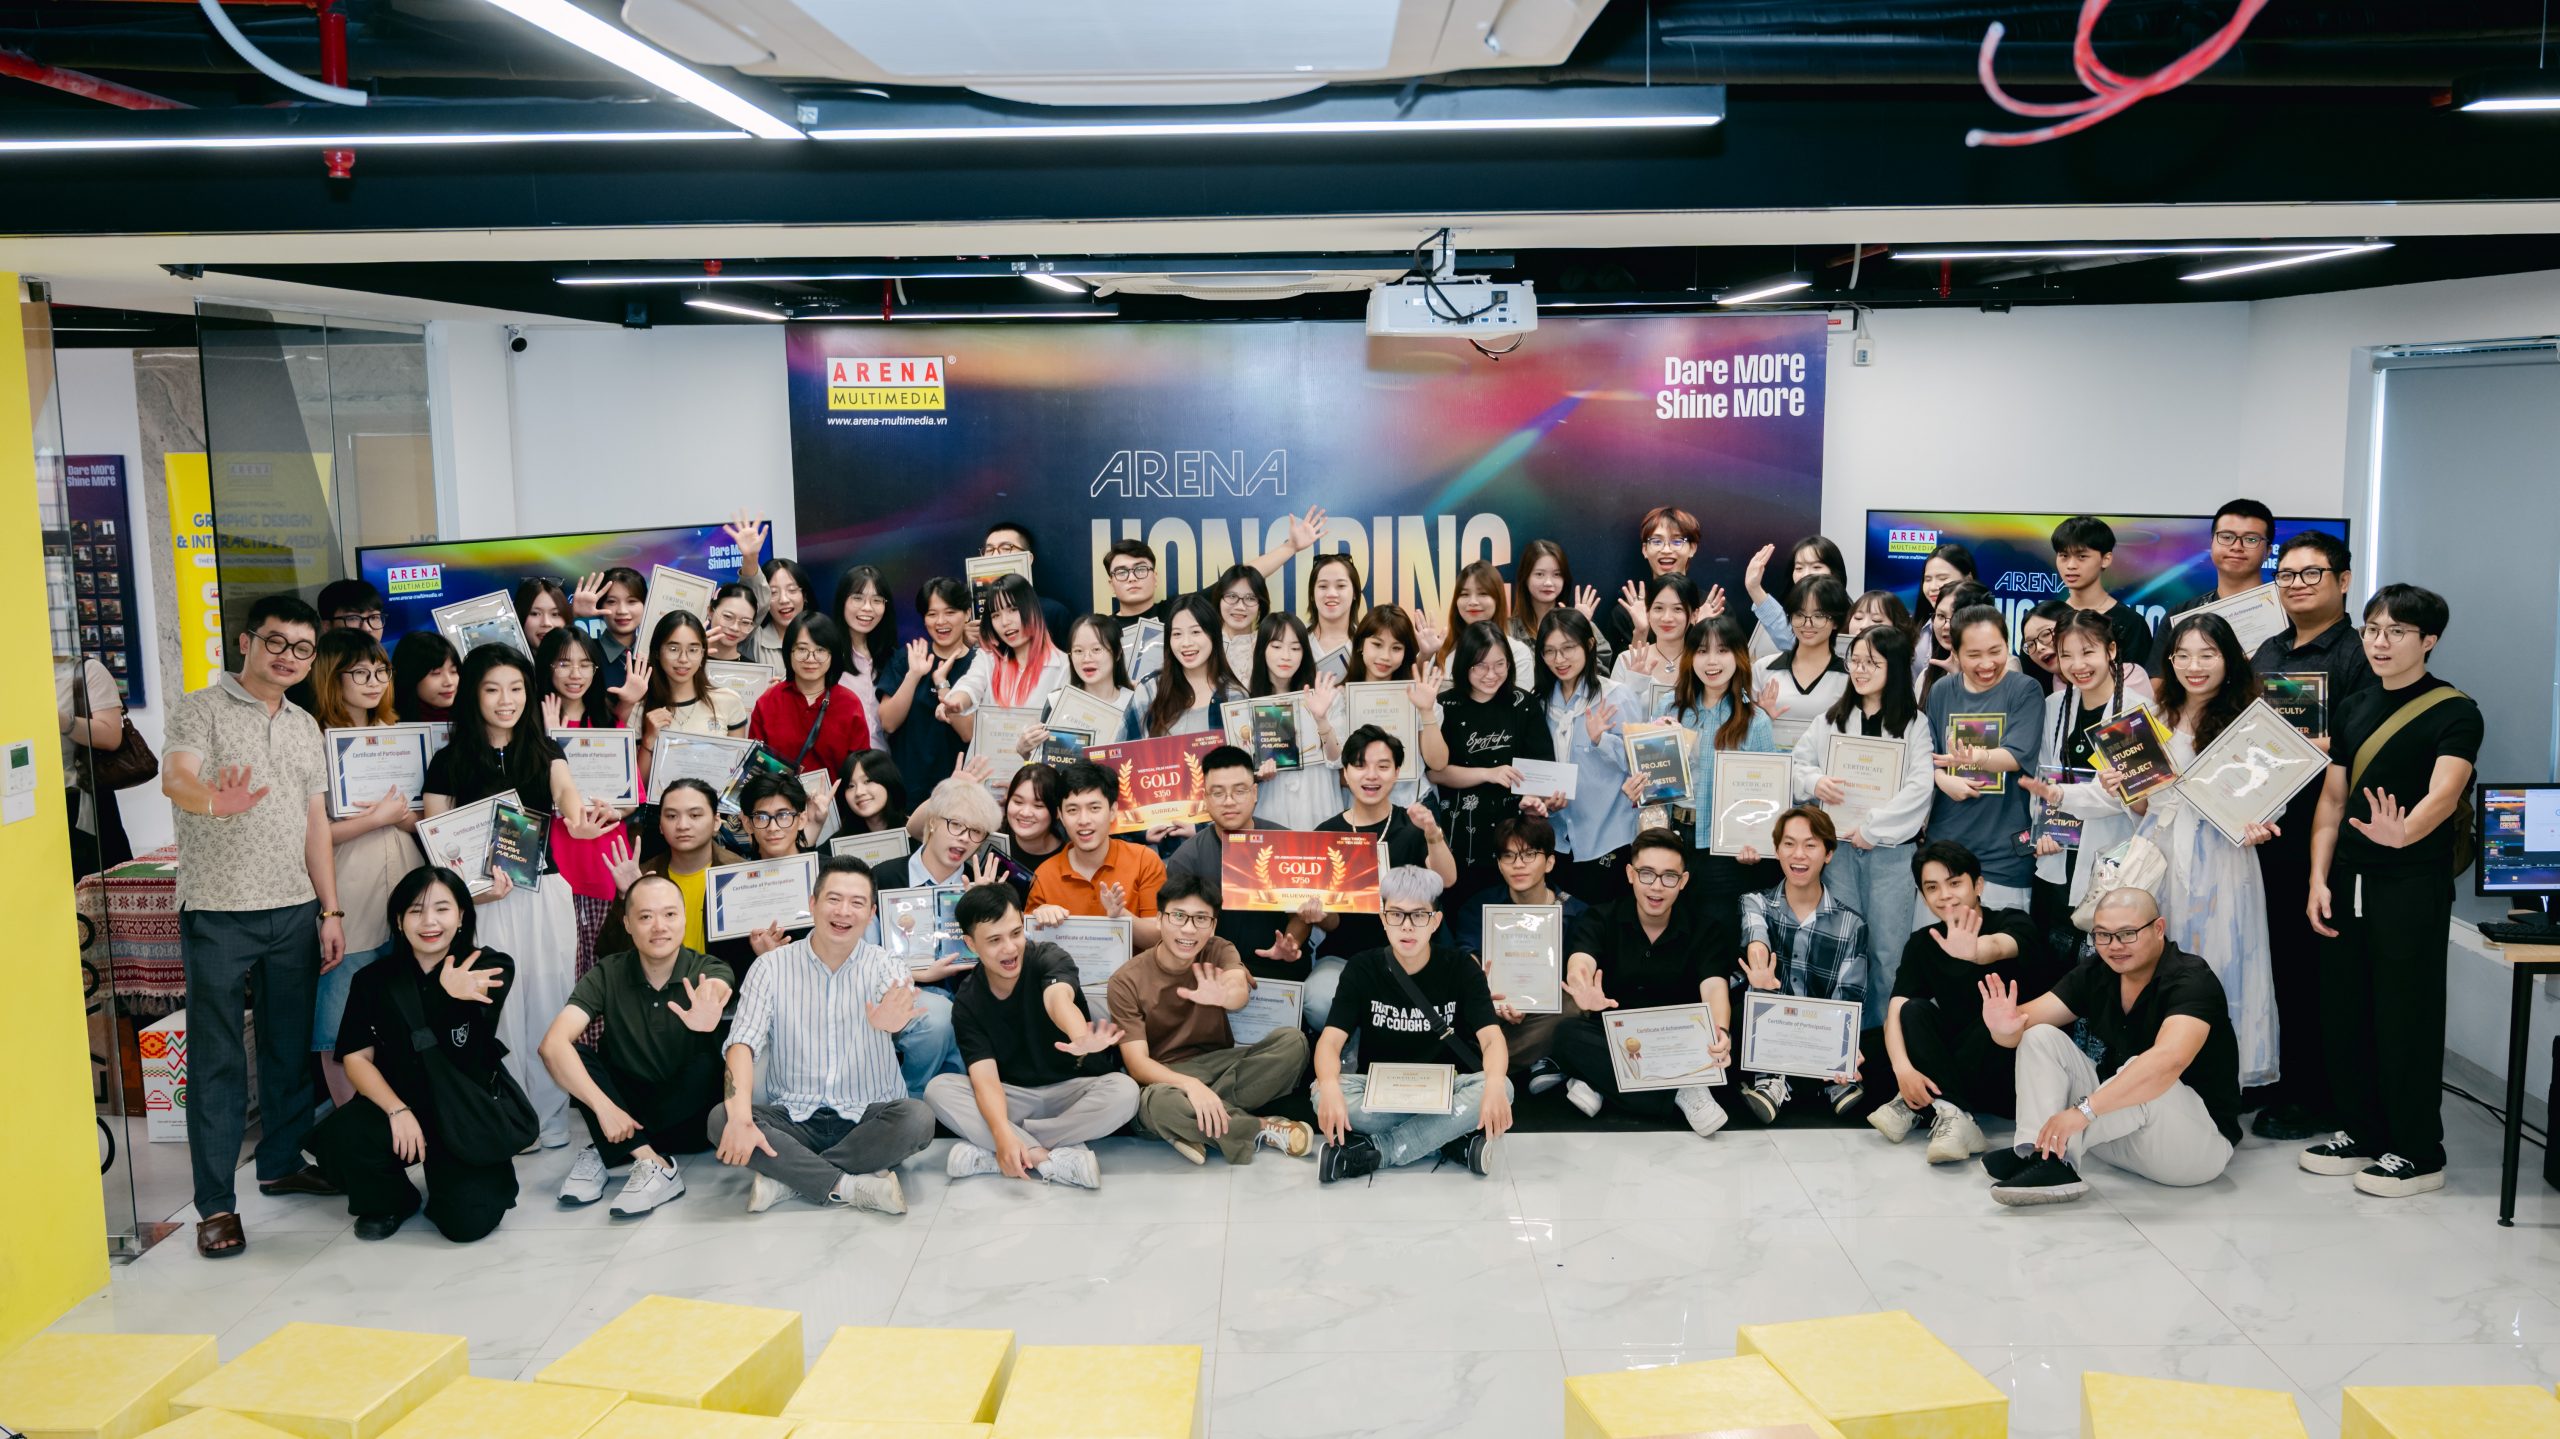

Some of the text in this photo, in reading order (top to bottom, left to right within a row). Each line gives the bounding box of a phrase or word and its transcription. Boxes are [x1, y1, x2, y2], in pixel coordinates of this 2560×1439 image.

[833, 362, 939, 382] ARENA
[1664, 356, 1729, 386] Dare
[833, 392, 940, 405] MULTIMEDIA
[1656, 388, 1728, 420] Shine
[827, 415, 948, 426] www.arena-multimedia.vn
[67, 465, 90, 476] Dare
[1090, 449, 1287, 498] ARENA
[66, 476, 91, 487] Shine
[262, 514, 312, 528] DESIGN
[176, 535, 189, 549] &
[191, 534, 280, 549] INTRACTIVE
[1891, 531, 1935, 542] ARENA
[709, 545, 730, 557] Dare
[708, 557, 731, 570] Shine
[390, 566, 439, 581] ARENA
[391, 581, 440, 592] MULTIMEDIA
[2275, 707, 2306, 715] CULTY
[352, 751, 377, 759] Certificate
[383, 750, 411, 758] Participation
[2112, 742, 2145, 762] STUDENT
[1047, 754, 1077, 764] PROJECT
[1640, 760, 1671, 770] PROJECT
[1842, 763, 1884, 773] CERTIFICATE
[2117, 761, 2128, 771] OF
[2121, 761, 2153, 780] SUBJECT
[1140, 771, 1181, 790] GOLD
[1645, 776, 1677, 786] EMESTER
[1151, 806, 1180, 815] SURREAL
[2045, 808, 2056, 816] OF
[2044, 818, 2082, 828] ACTIVITY
[1278, 862, 1322, 876] GOLD
[732, 884, 758, 892] Certificate
[763, 878, 795, 887] Participation
[1370, 1000, 1400, 1018] THAT'S
[1400, 1007, 1408, 1019] A
[1444, 1001, 1457, 1015] LOT
[1372, 1013, 1387, 1028] OF
[1386, 1017, 1423, 1032] COUGH
[1767, 1018, 1794, 1026] Certificate
[1799, 1022, 1832, 1031] Participation
